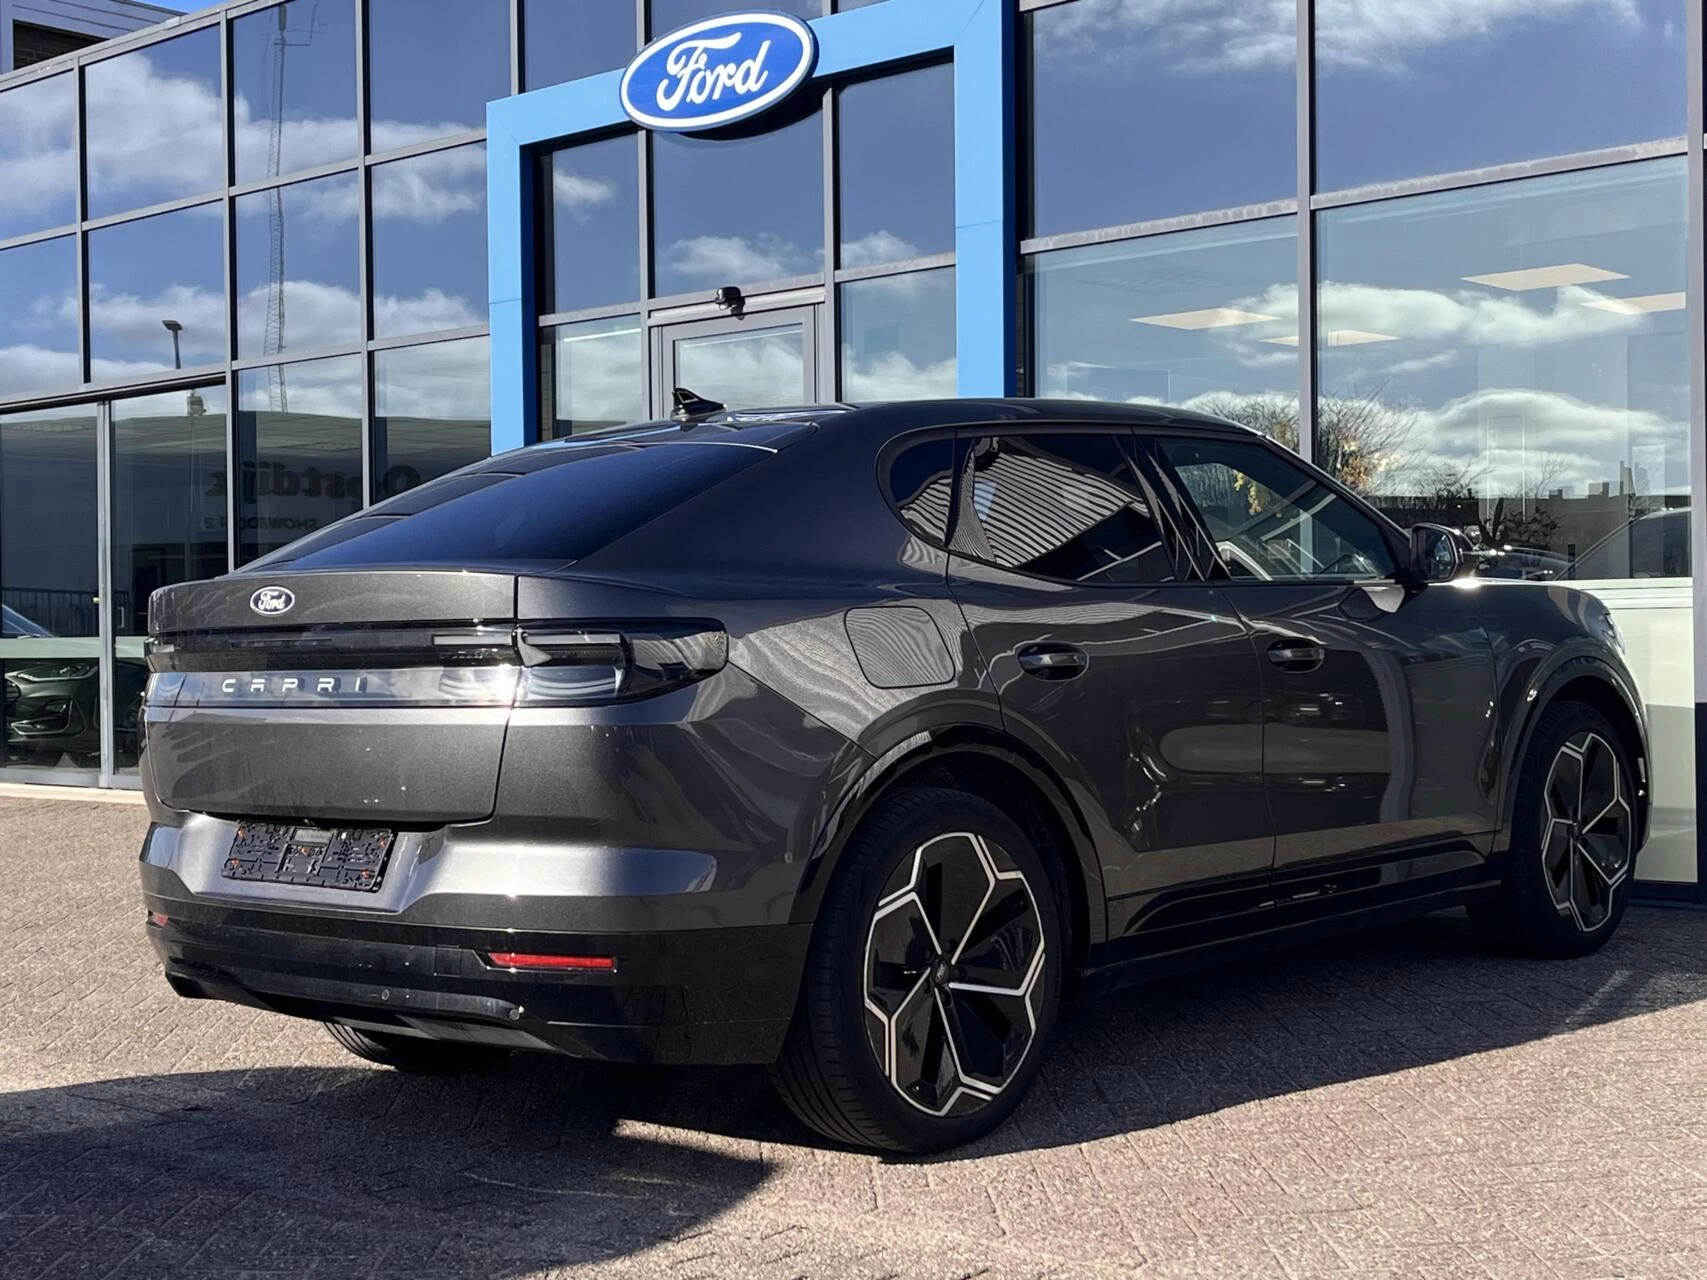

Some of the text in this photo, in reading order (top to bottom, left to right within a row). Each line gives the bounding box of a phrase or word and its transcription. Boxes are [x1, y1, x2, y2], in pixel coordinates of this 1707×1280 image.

[656, 32, 771, 111] Ford
[258, 591, 286, 610] Ford
[222, 677, 362, 693] CAPRI
